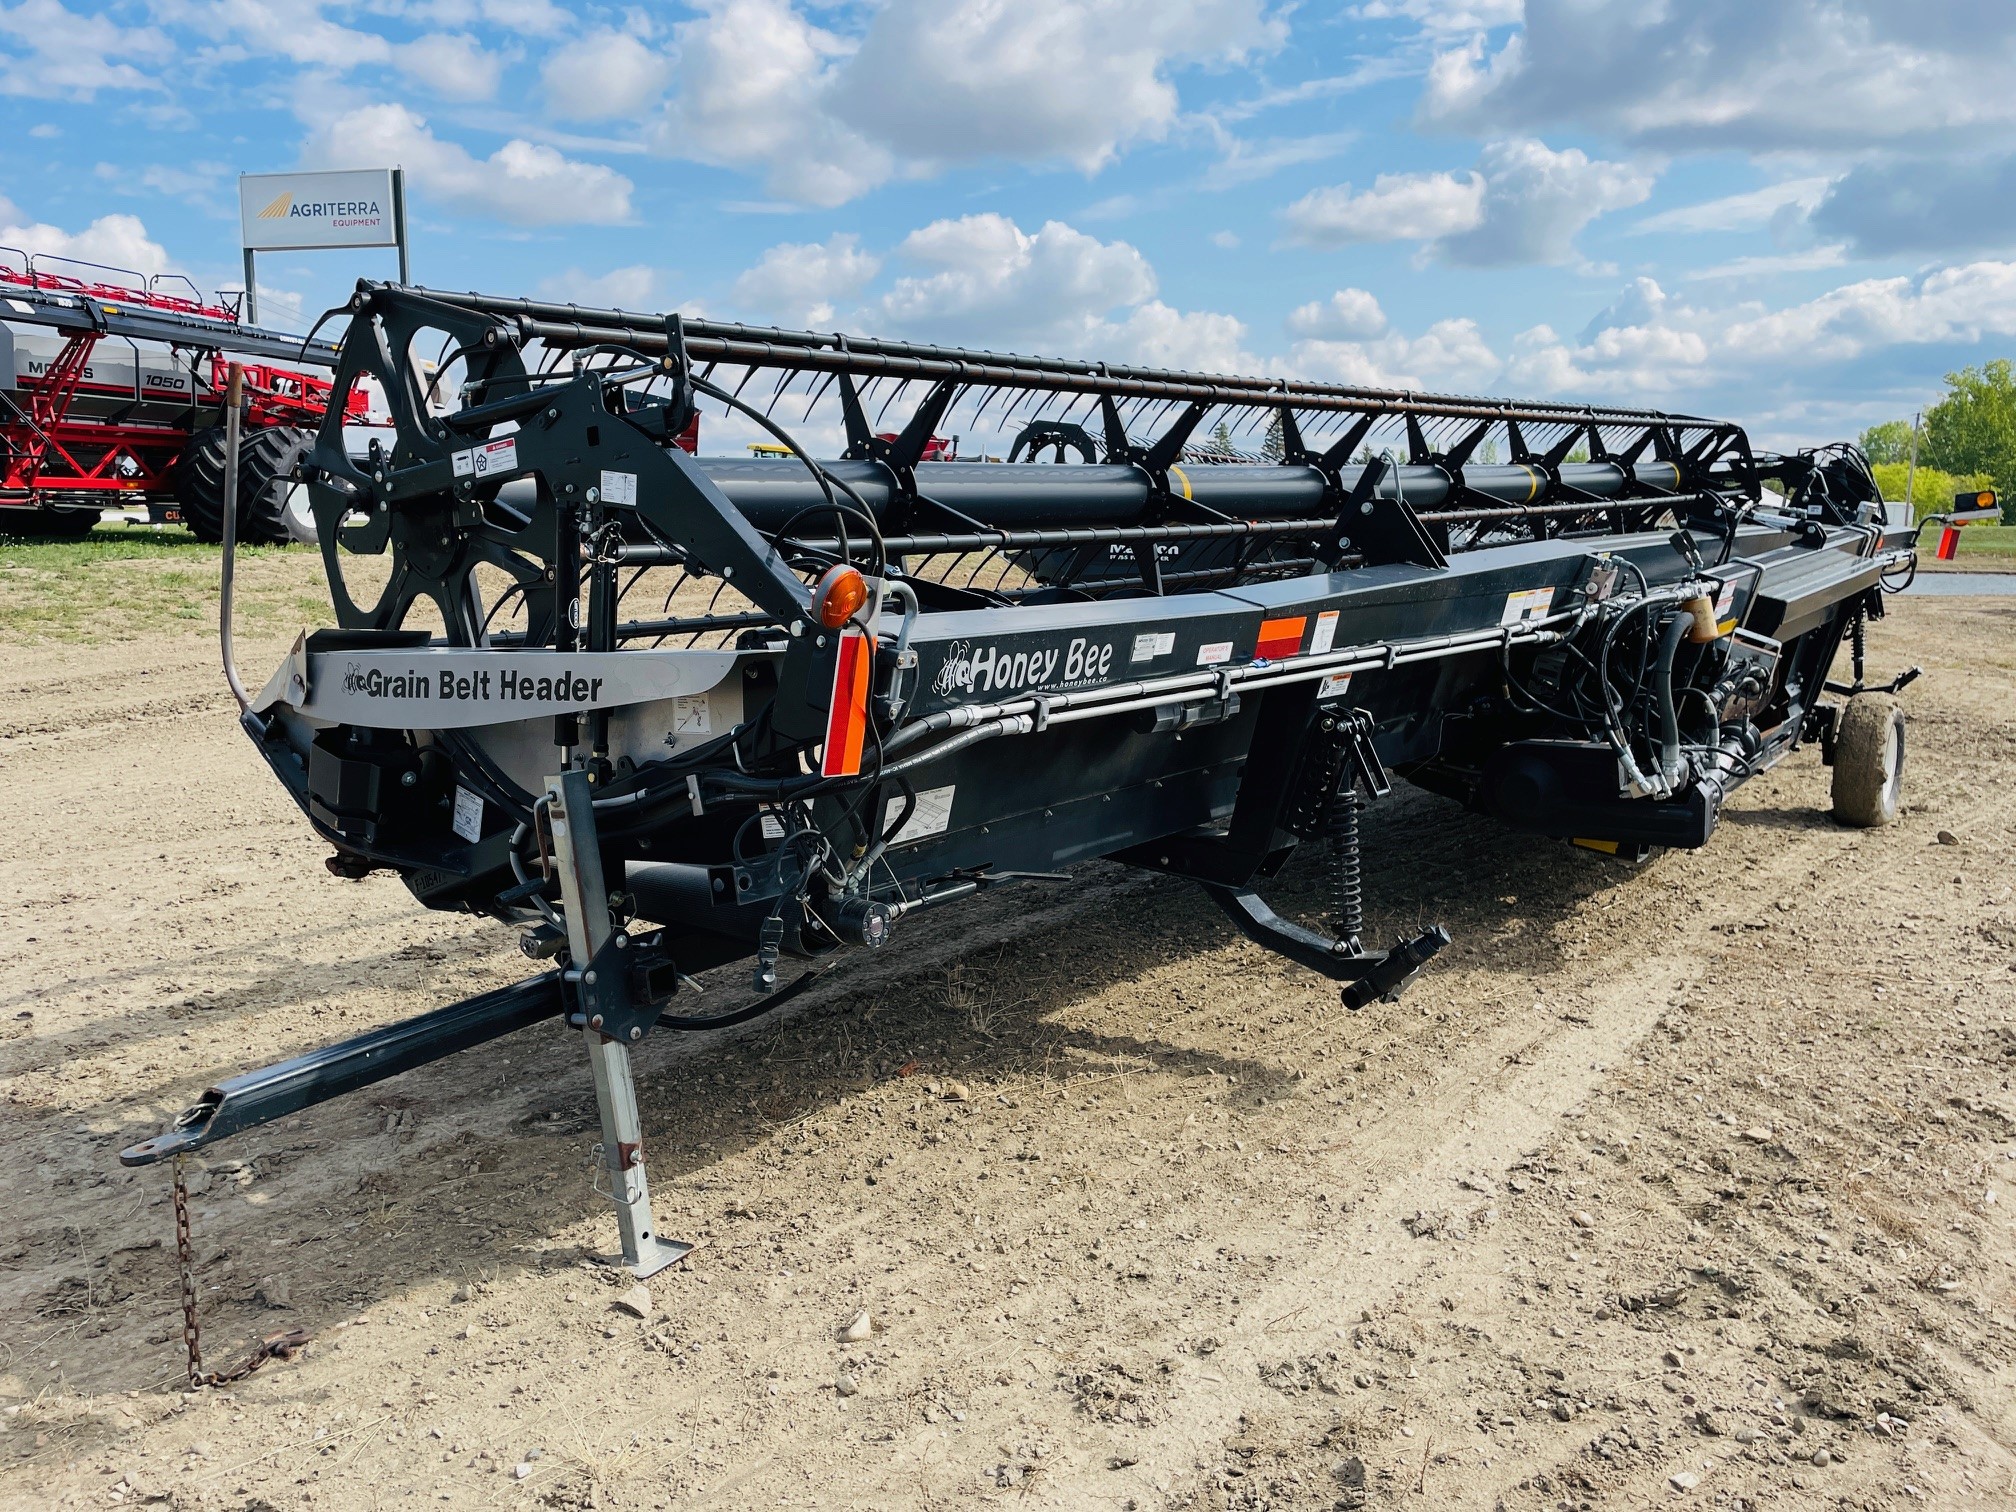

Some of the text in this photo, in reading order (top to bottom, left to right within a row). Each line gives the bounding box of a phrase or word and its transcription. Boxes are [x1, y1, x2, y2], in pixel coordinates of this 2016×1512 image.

[290, 202, 380, 217] AGRITERRA
[333, 219, 381, 227] EQUIPMENT
[28, 361, 94, 379] MOS
[146, 375, 185, 390] 1050
[966, 647, 1059, 695] Honey
[1064, 637, 1113, 678] Bee
[366, 669, 603, 702] Grain Belt Header
[1037, 675, 1108, 693] www.honeybee.ca
